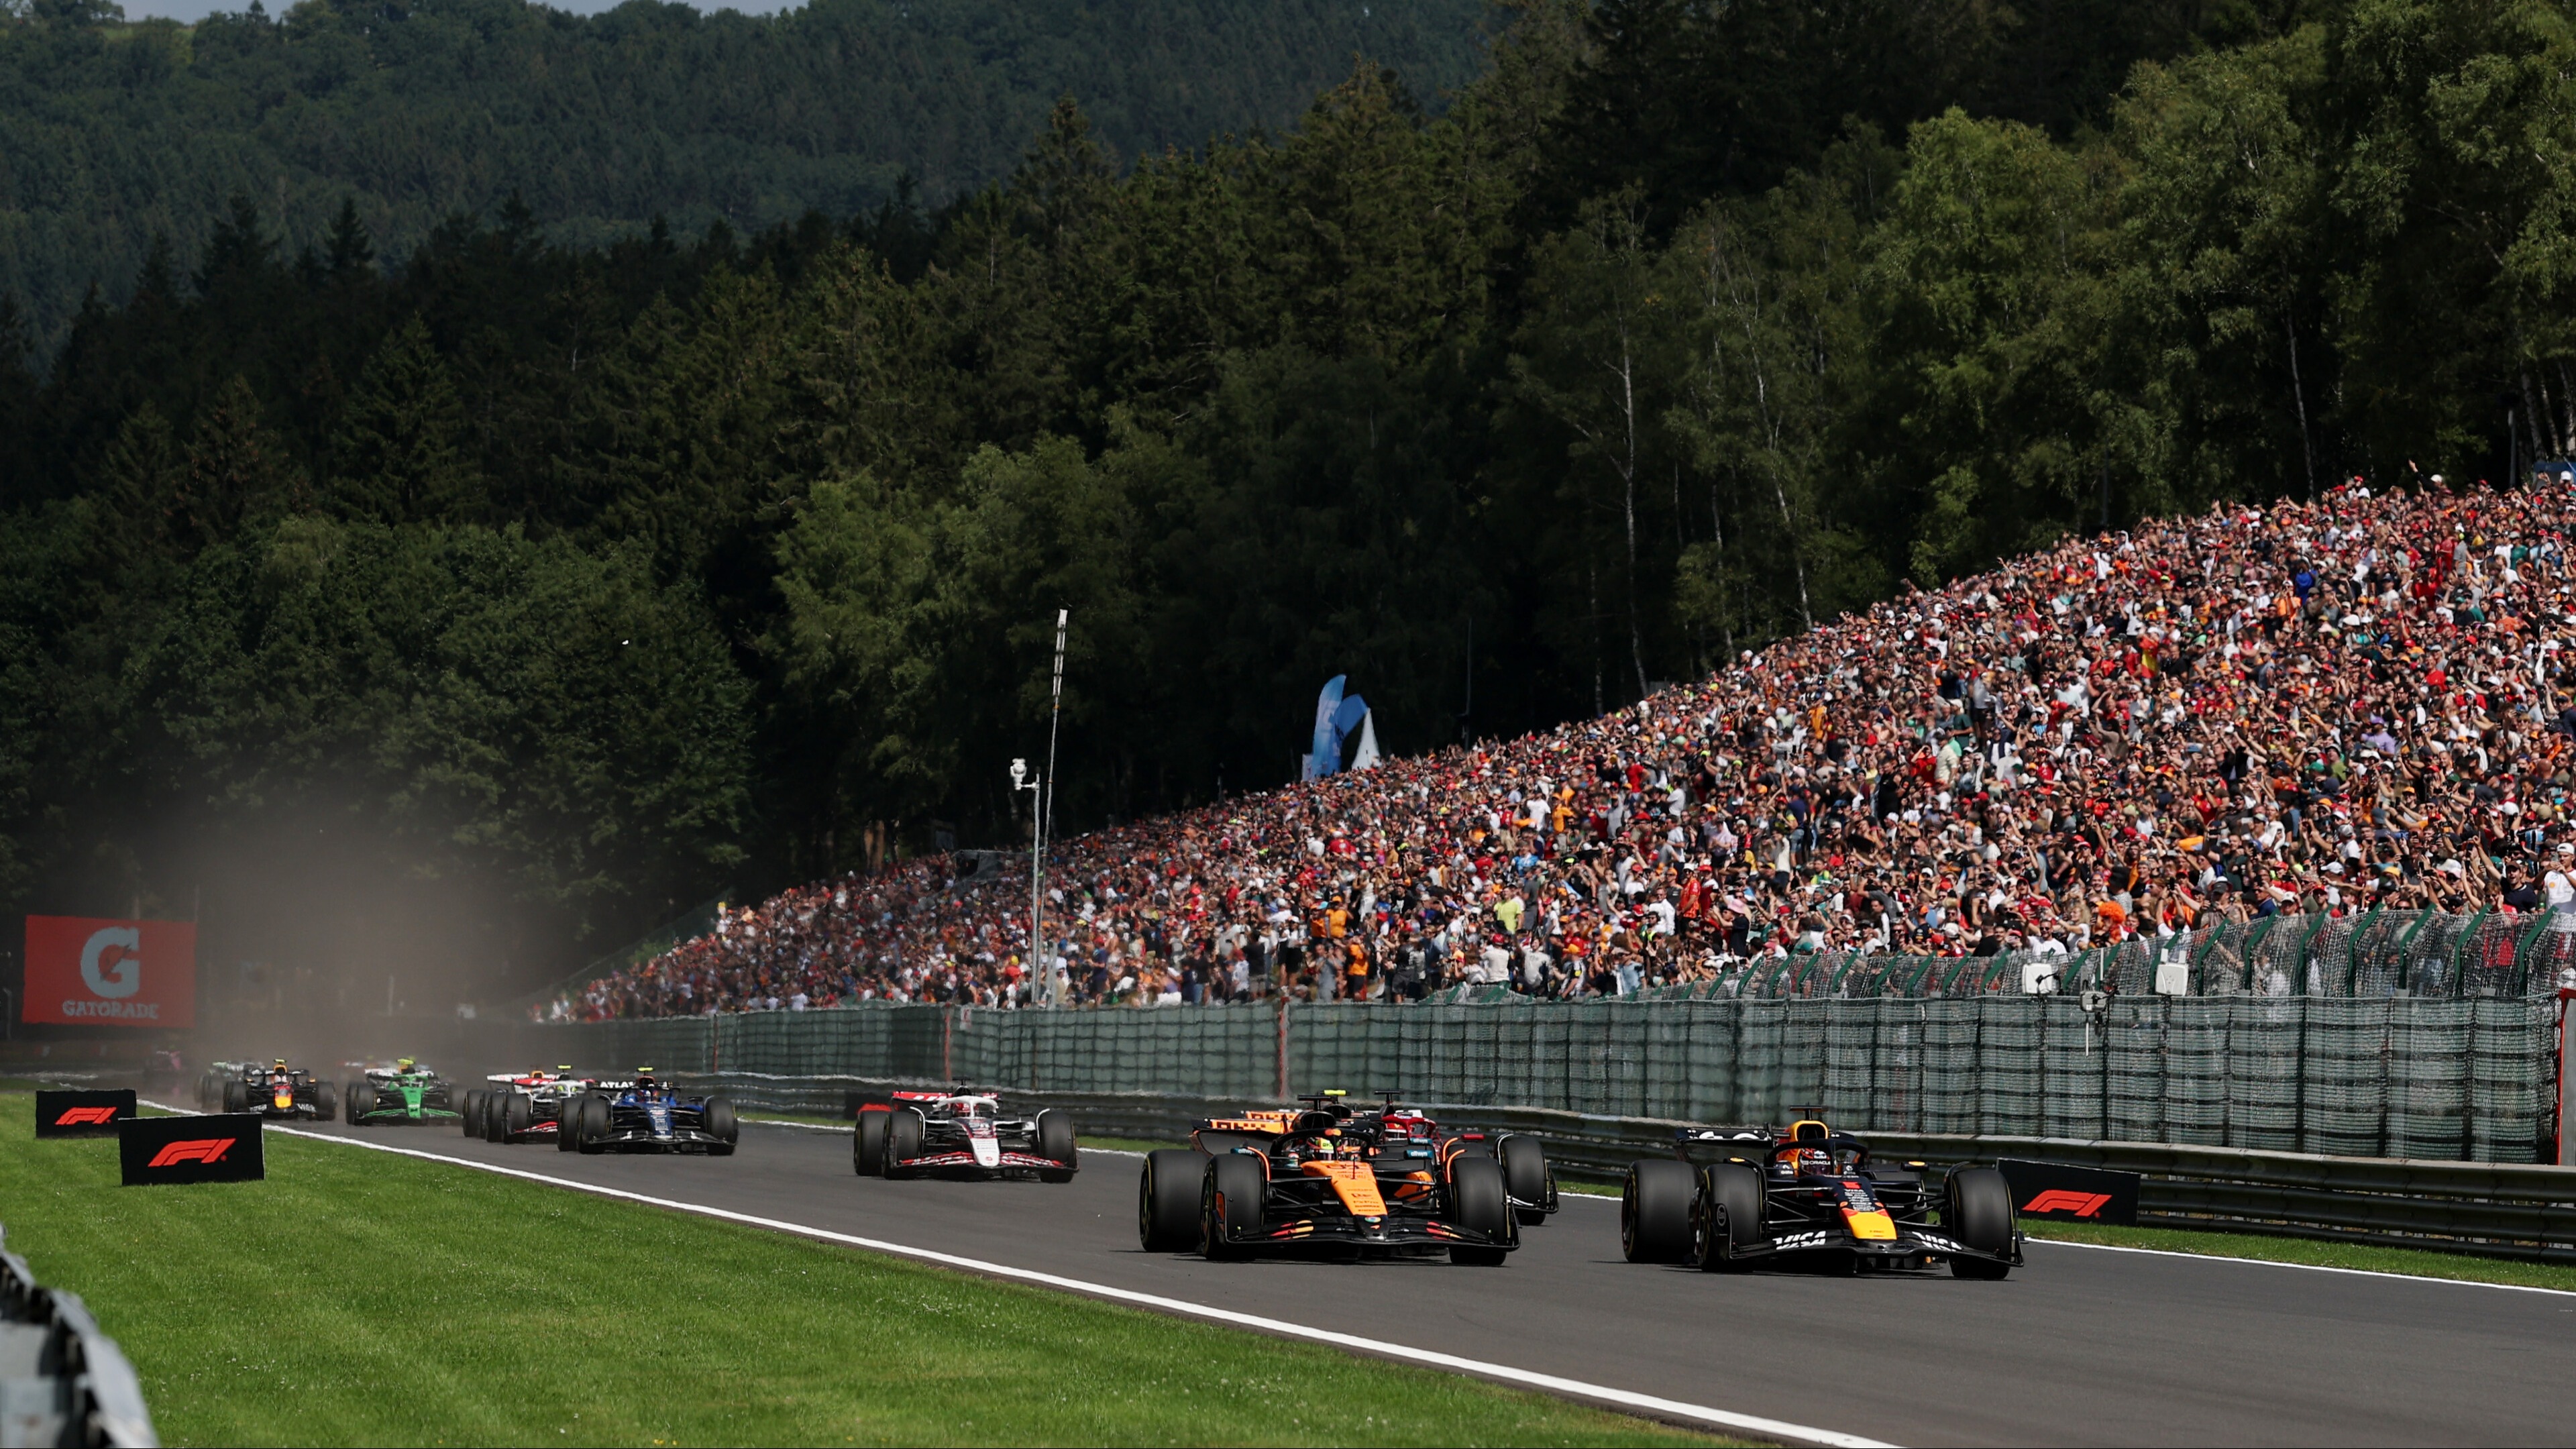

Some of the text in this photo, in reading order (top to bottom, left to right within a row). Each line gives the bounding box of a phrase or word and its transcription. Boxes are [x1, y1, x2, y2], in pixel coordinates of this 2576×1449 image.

[80, 926, 140, 998] G
[62, 1000, 158, 1019] GATORADE
[2023, 1189, 2112, 1216] F1
[1772, 1230, 1827, 1250] VISA
